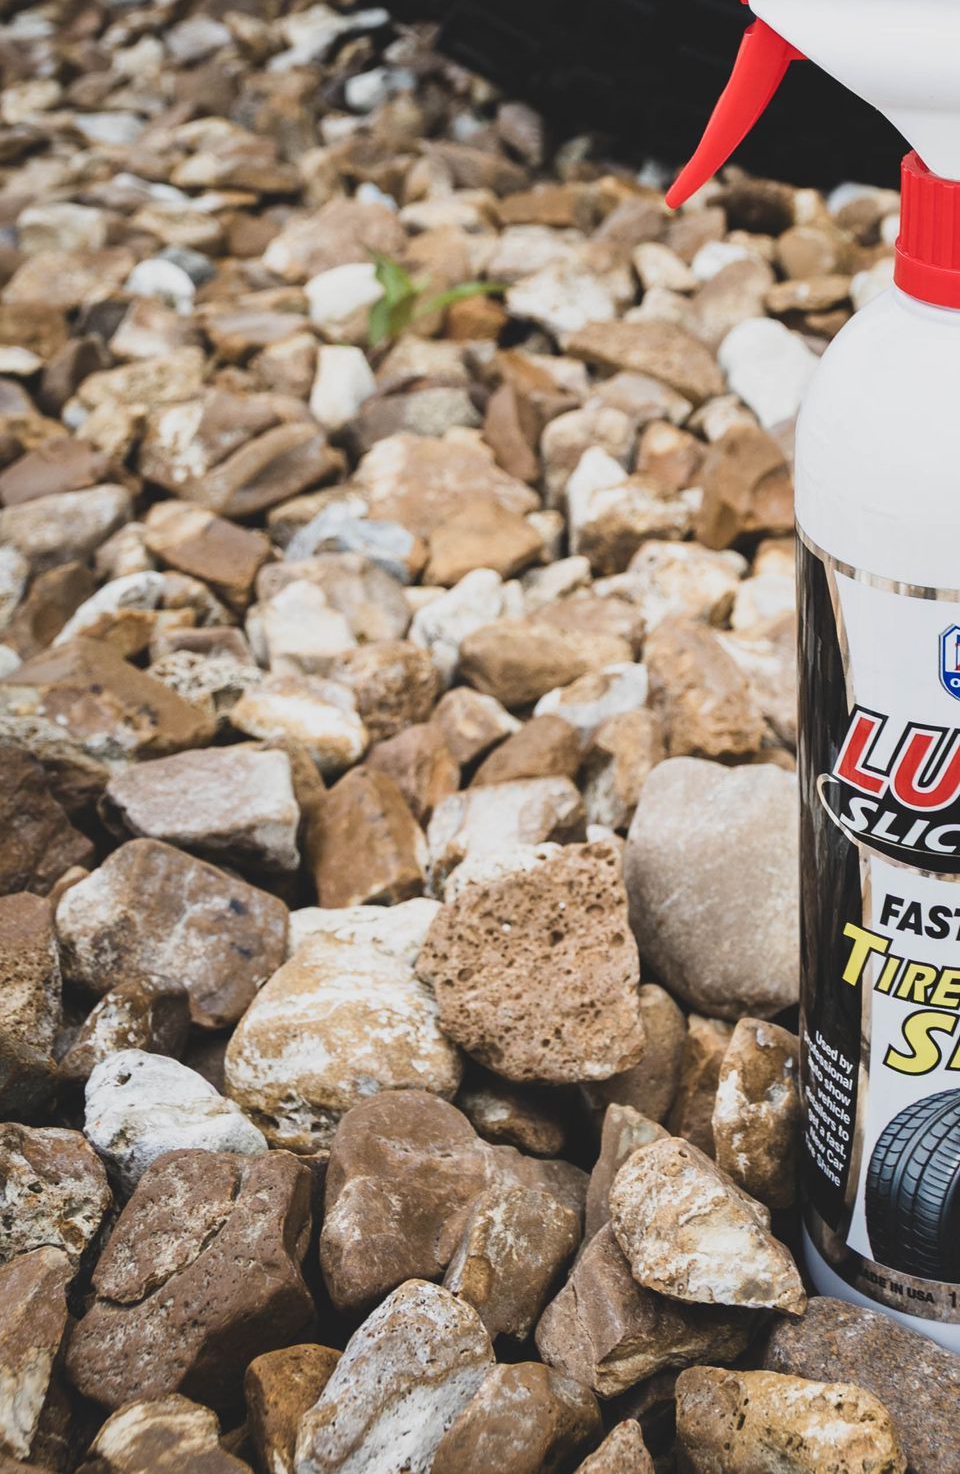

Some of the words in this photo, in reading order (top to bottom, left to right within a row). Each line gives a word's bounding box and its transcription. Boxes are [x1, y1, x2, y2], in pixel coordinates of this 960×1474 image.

[815, 1030, 838, 1061] Used
[839, 1054, 853, 1074] by
[817, 1087, 851, 1124] vehicle
[824, 1078, 851, 1106] show
[838, 1125, 850, 1141] to
[816, 1153, 841, 1187] Shine
[827, 1149, 844, 1171] Car
[907, 1287, 935, 1304] USA
